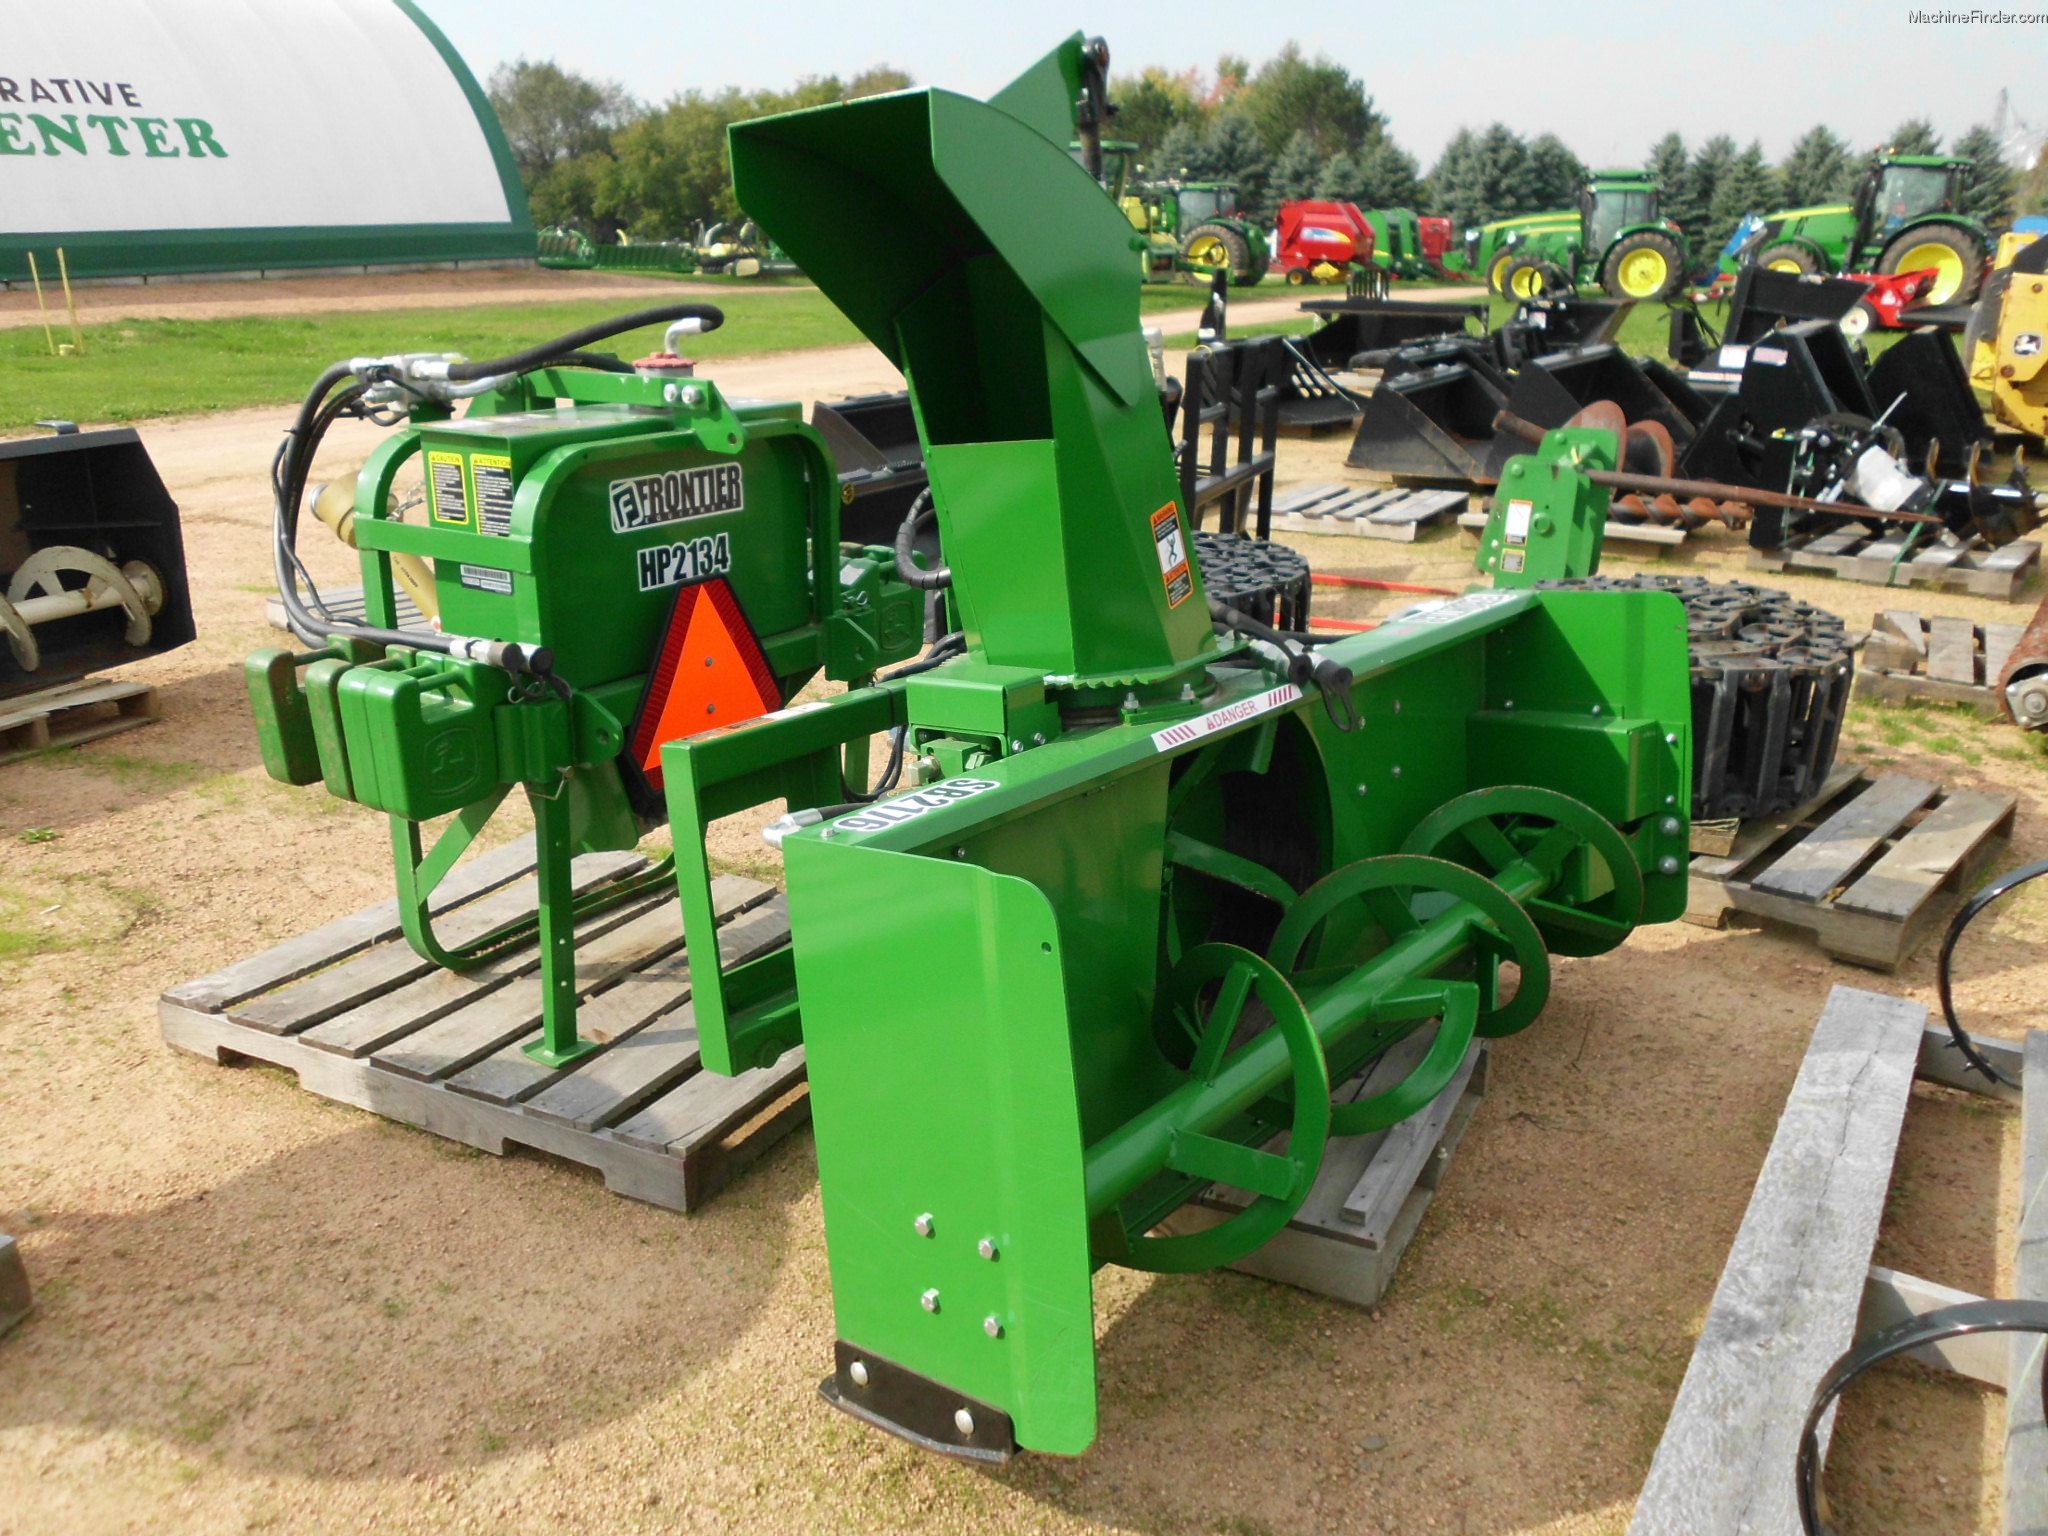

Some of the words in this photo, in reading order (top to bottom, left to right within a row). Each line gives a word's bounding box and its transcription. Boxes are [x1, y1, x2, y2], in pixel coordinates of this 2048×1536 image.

[0, 112, 229, 158] ENTER
[636, 464, 742, 518] FRONTIER
[639, 534, 730, 591] HP2134
[1213, 700, 1257, 727] DANGER
[837, 778, 998, 831] SB2176
